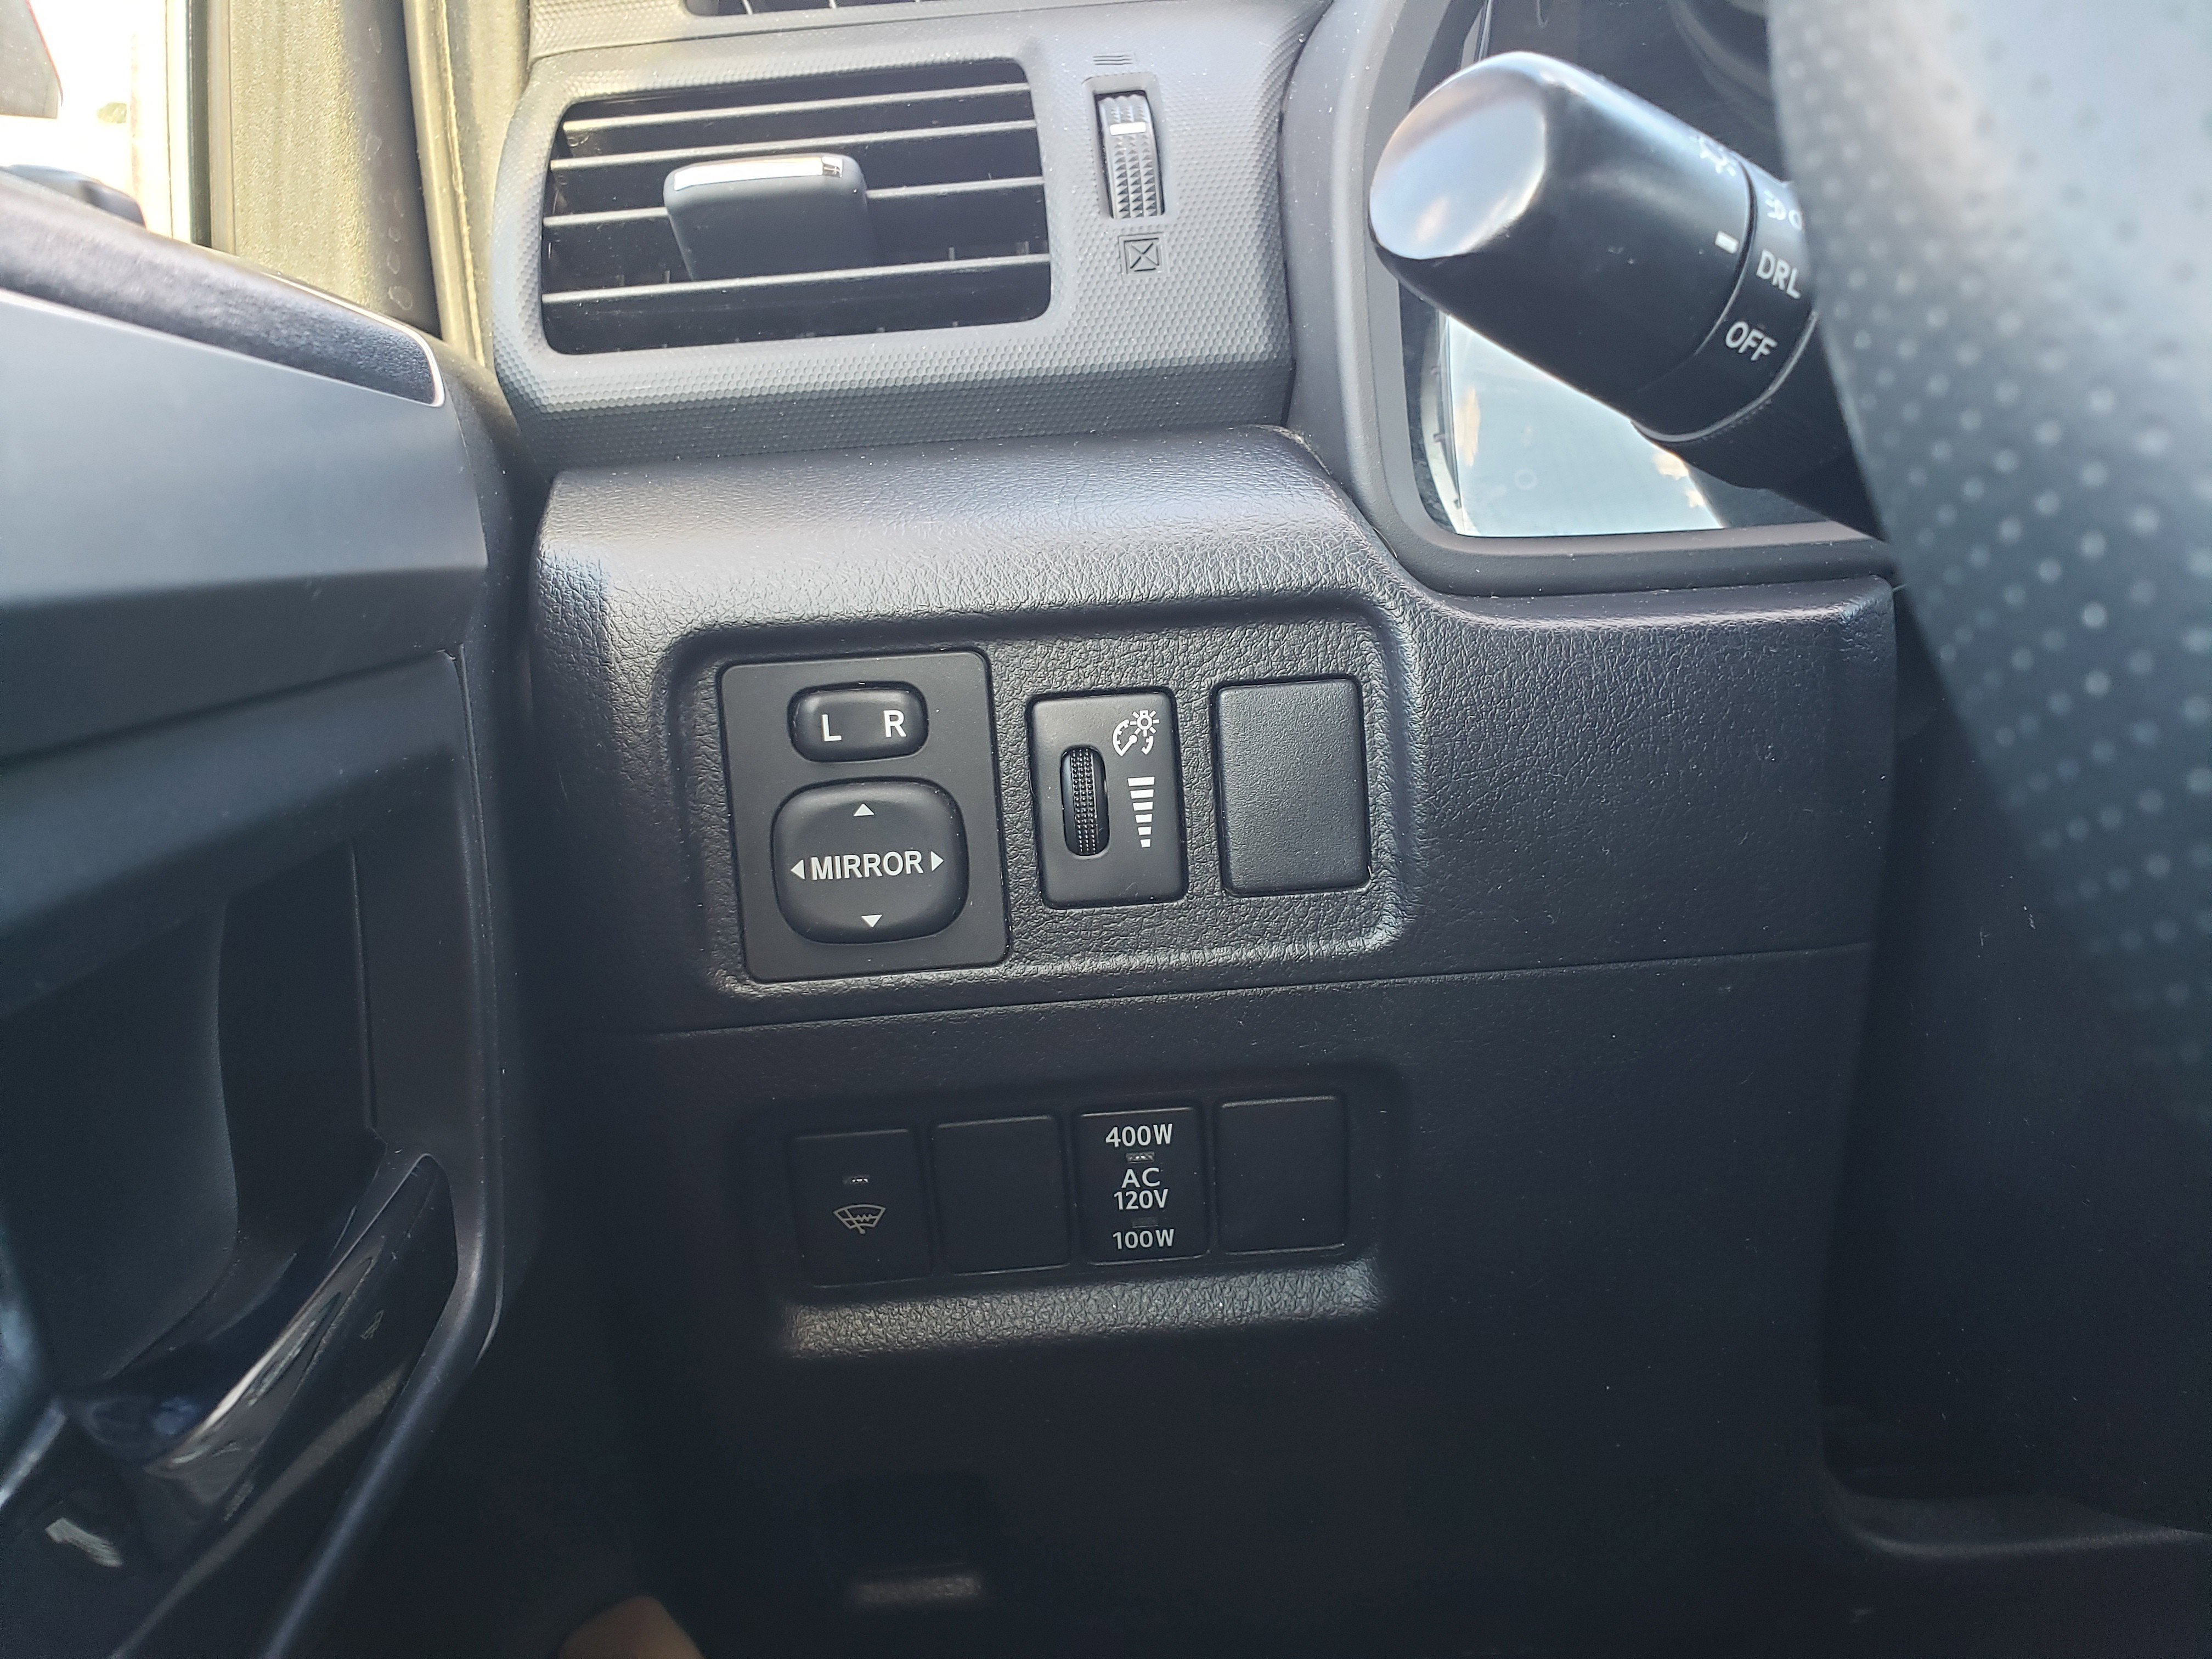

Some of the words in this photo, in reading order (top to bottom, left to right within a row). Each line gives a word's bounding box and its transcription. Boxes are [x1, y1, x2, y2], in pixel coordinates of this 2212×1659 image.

[1756, 249, 1801, 299] DRL
[1725, 321, 1777, 360] OFF
[821, 714, 842, 742] L
[883, 710, 907, 738] R
[811, 850, 924, 881] MIRROR
[1105, 1123, 1173, 1147] 400W
[1121, 1167, 1160, 1188] AC
[1114, 1188, 1169, 1210] 120V
[1113, 1228, 1174, 1249] 100W
